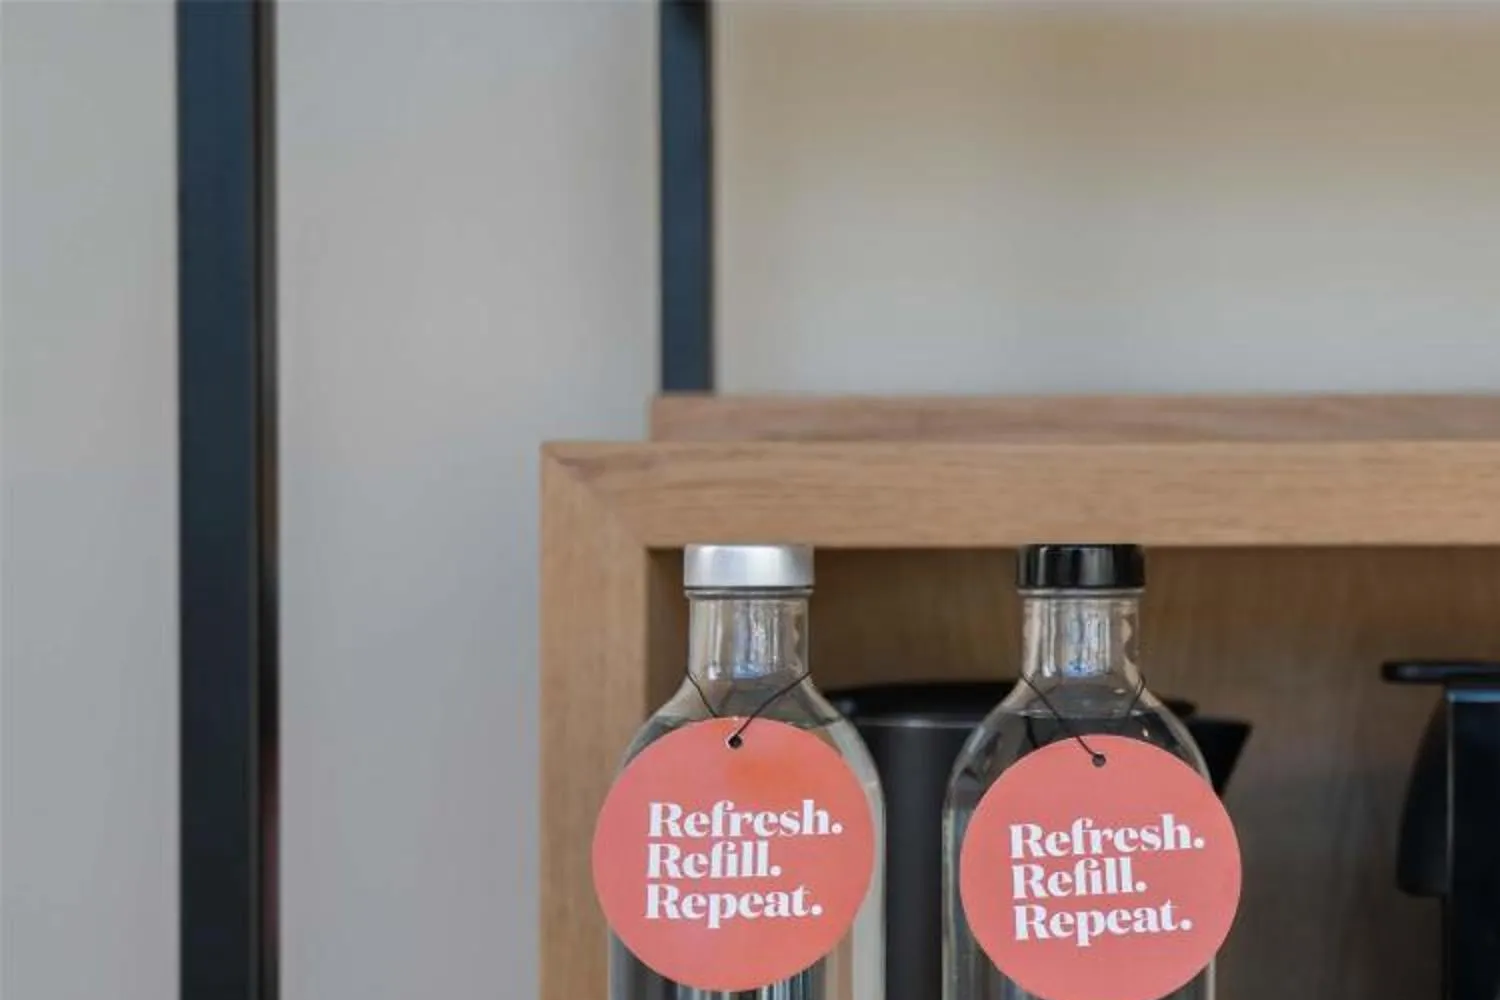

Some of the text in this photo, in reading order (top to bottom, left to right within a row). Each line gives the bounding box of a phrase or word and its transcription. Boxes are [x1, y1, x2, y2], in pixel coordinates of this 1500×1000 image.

[648, 800, 843, 838] Refresh.
[1010, 813, 1205, 859] Refresh.
[647, 840, 782, 879] Refill.
[1012, 856, 1148, 900] Refill.
[645, 884, 823, 929] Repeat.
[1014, 900, 1193, 947] Repeat.
